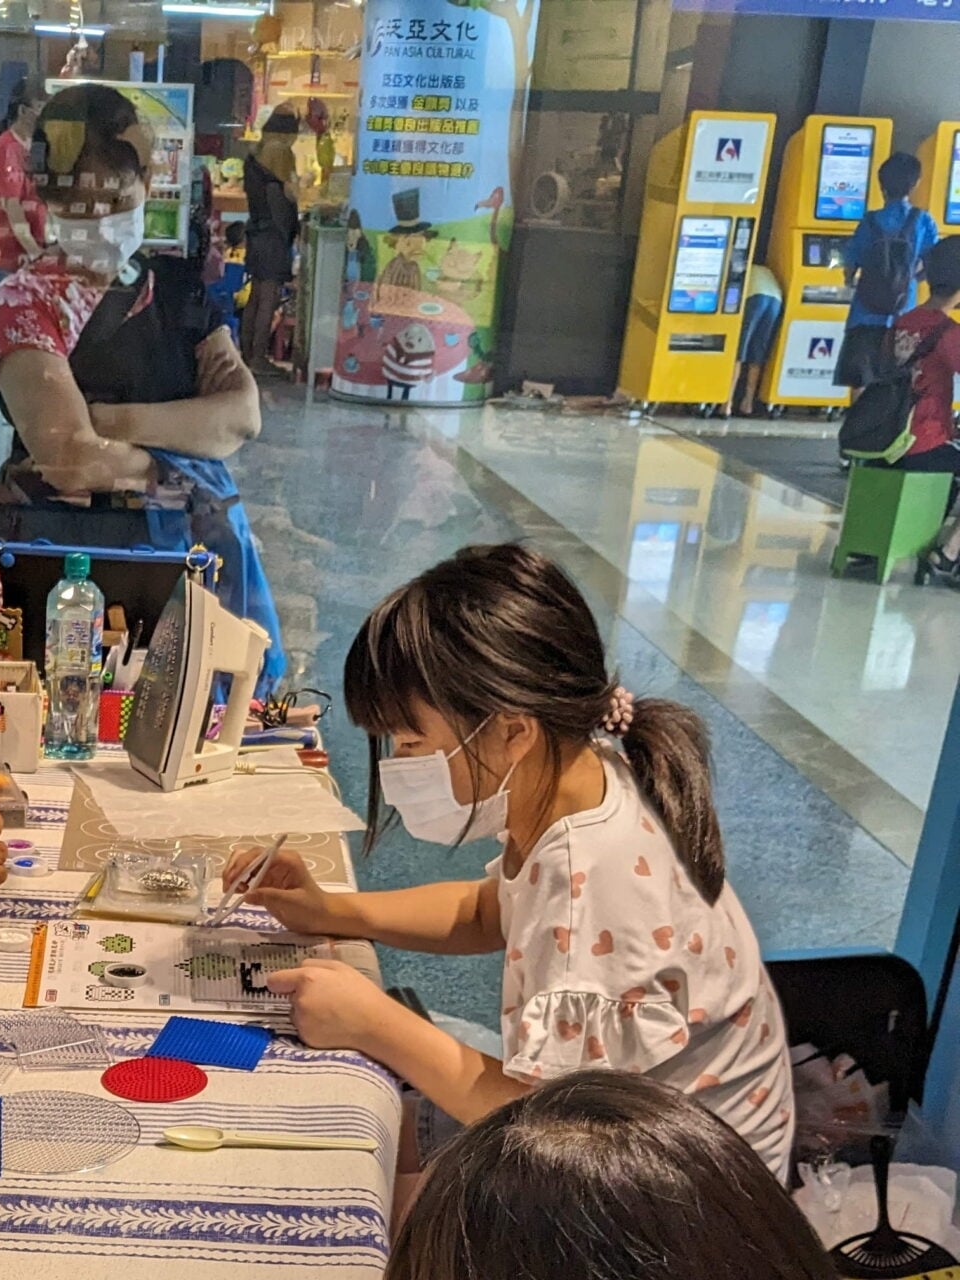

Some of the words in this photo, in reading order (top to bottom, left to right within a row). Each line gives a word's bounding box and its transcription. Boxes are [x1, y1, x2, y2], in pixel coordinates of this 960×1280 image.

[385, 18, 479, 42] 泛亞文化
[402, 47, 423, 58] ASIA
[426, 47, 476, 59] CULTURAL
[382, 73, 466, 90] 泛亞文化出版品
[455, 99, 479, 111] 以及
